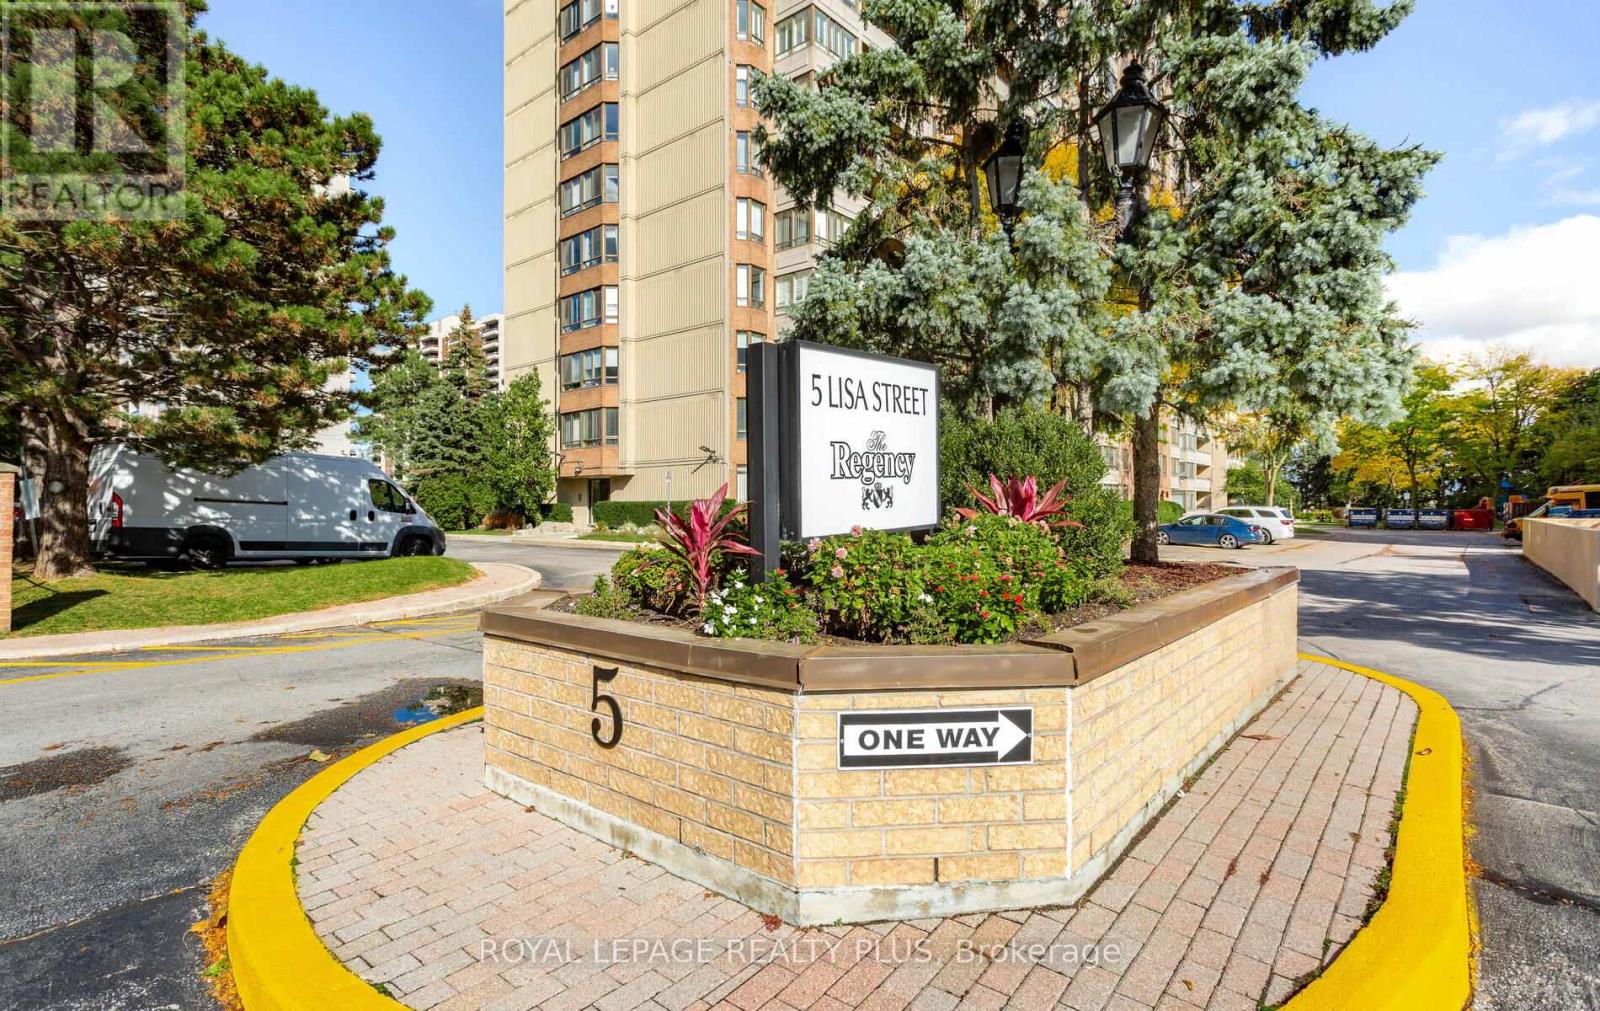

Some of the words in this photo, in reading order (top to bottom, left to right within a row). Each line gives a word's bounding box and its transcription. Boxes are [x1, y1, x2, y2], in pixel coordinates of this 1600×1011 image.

[811, 374, 823, 407] 5
[828, 375, 868, 411] LISA
[872, 381, 929, 416] STREET
[866, 430, 888, 452] The
[830, 441, 916, 485] Regency
[591, 665, 623, 750] 5
[858, 729, 925, 750] ONE
[936, 727, 1000, 748] WAY
